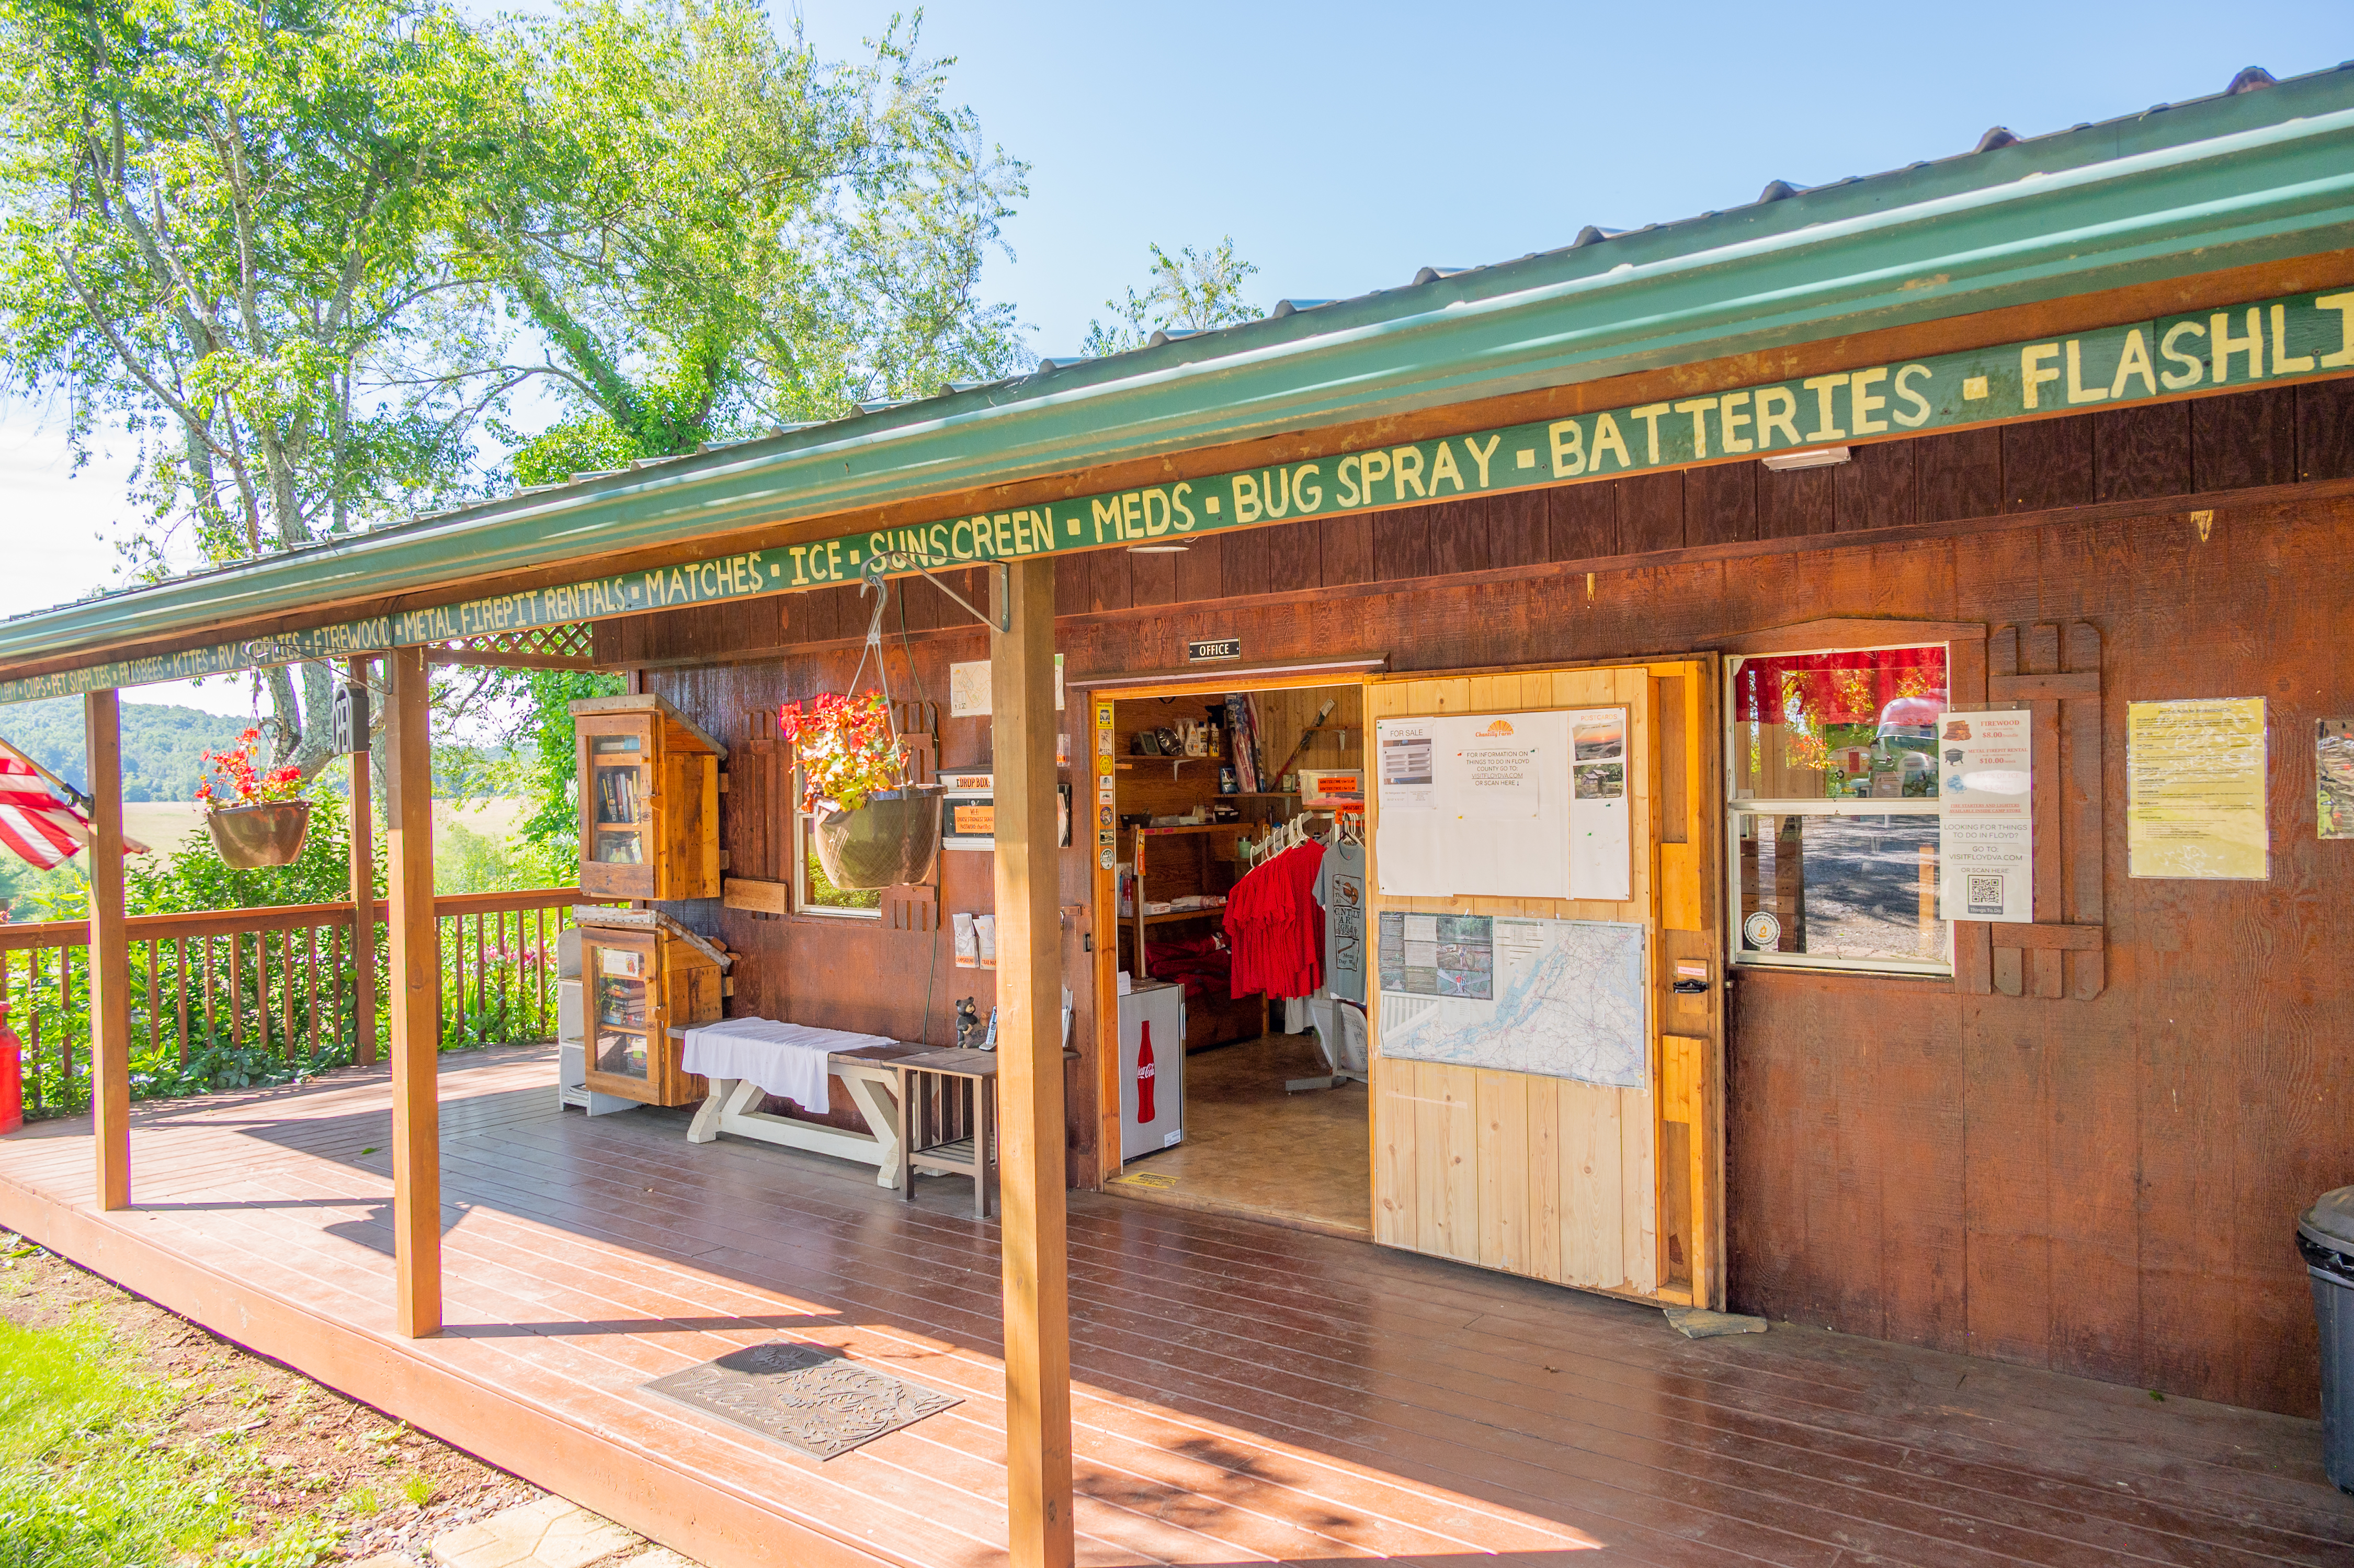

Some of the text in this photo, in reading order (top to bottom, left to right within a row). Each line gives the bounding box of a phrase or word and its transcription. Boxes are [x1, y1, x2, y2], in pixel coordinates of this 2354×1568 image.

[24, 677, 47, 699] CUPS
[51, 673, 66, 696] PET
[69, 665, 112, 693] SUPPLIES
[119, 656, 164, 685] FRISBEES
[173, 648, 209, 677] KITES
[218, 643, 235, 671] RV
[240, 631, 300, 667] SUPPLIES
[313, 616, 391, 656] FIREWOOD
[404, 606, 458, 642] METAL
[460, 590, 538, 634] FIREPIT
[544, 577, 626, 622] RENTALS
[645, 552, 764, 606] MATCHES
[789, 541, 843, 586] ICE
[869, 507, 1055, 573] SUNSCREEN
[1091, 482, 1196, 543] MEDS
[1232, 464, 1322, 524] BUG
[1336, 435, 1501, 508] SPRAY
[1548, 363, 1933, 479] BATTERIES
[1199, 643, 1229, 656] OFFICE
[960, 777, 988, 788] DROP BOX
